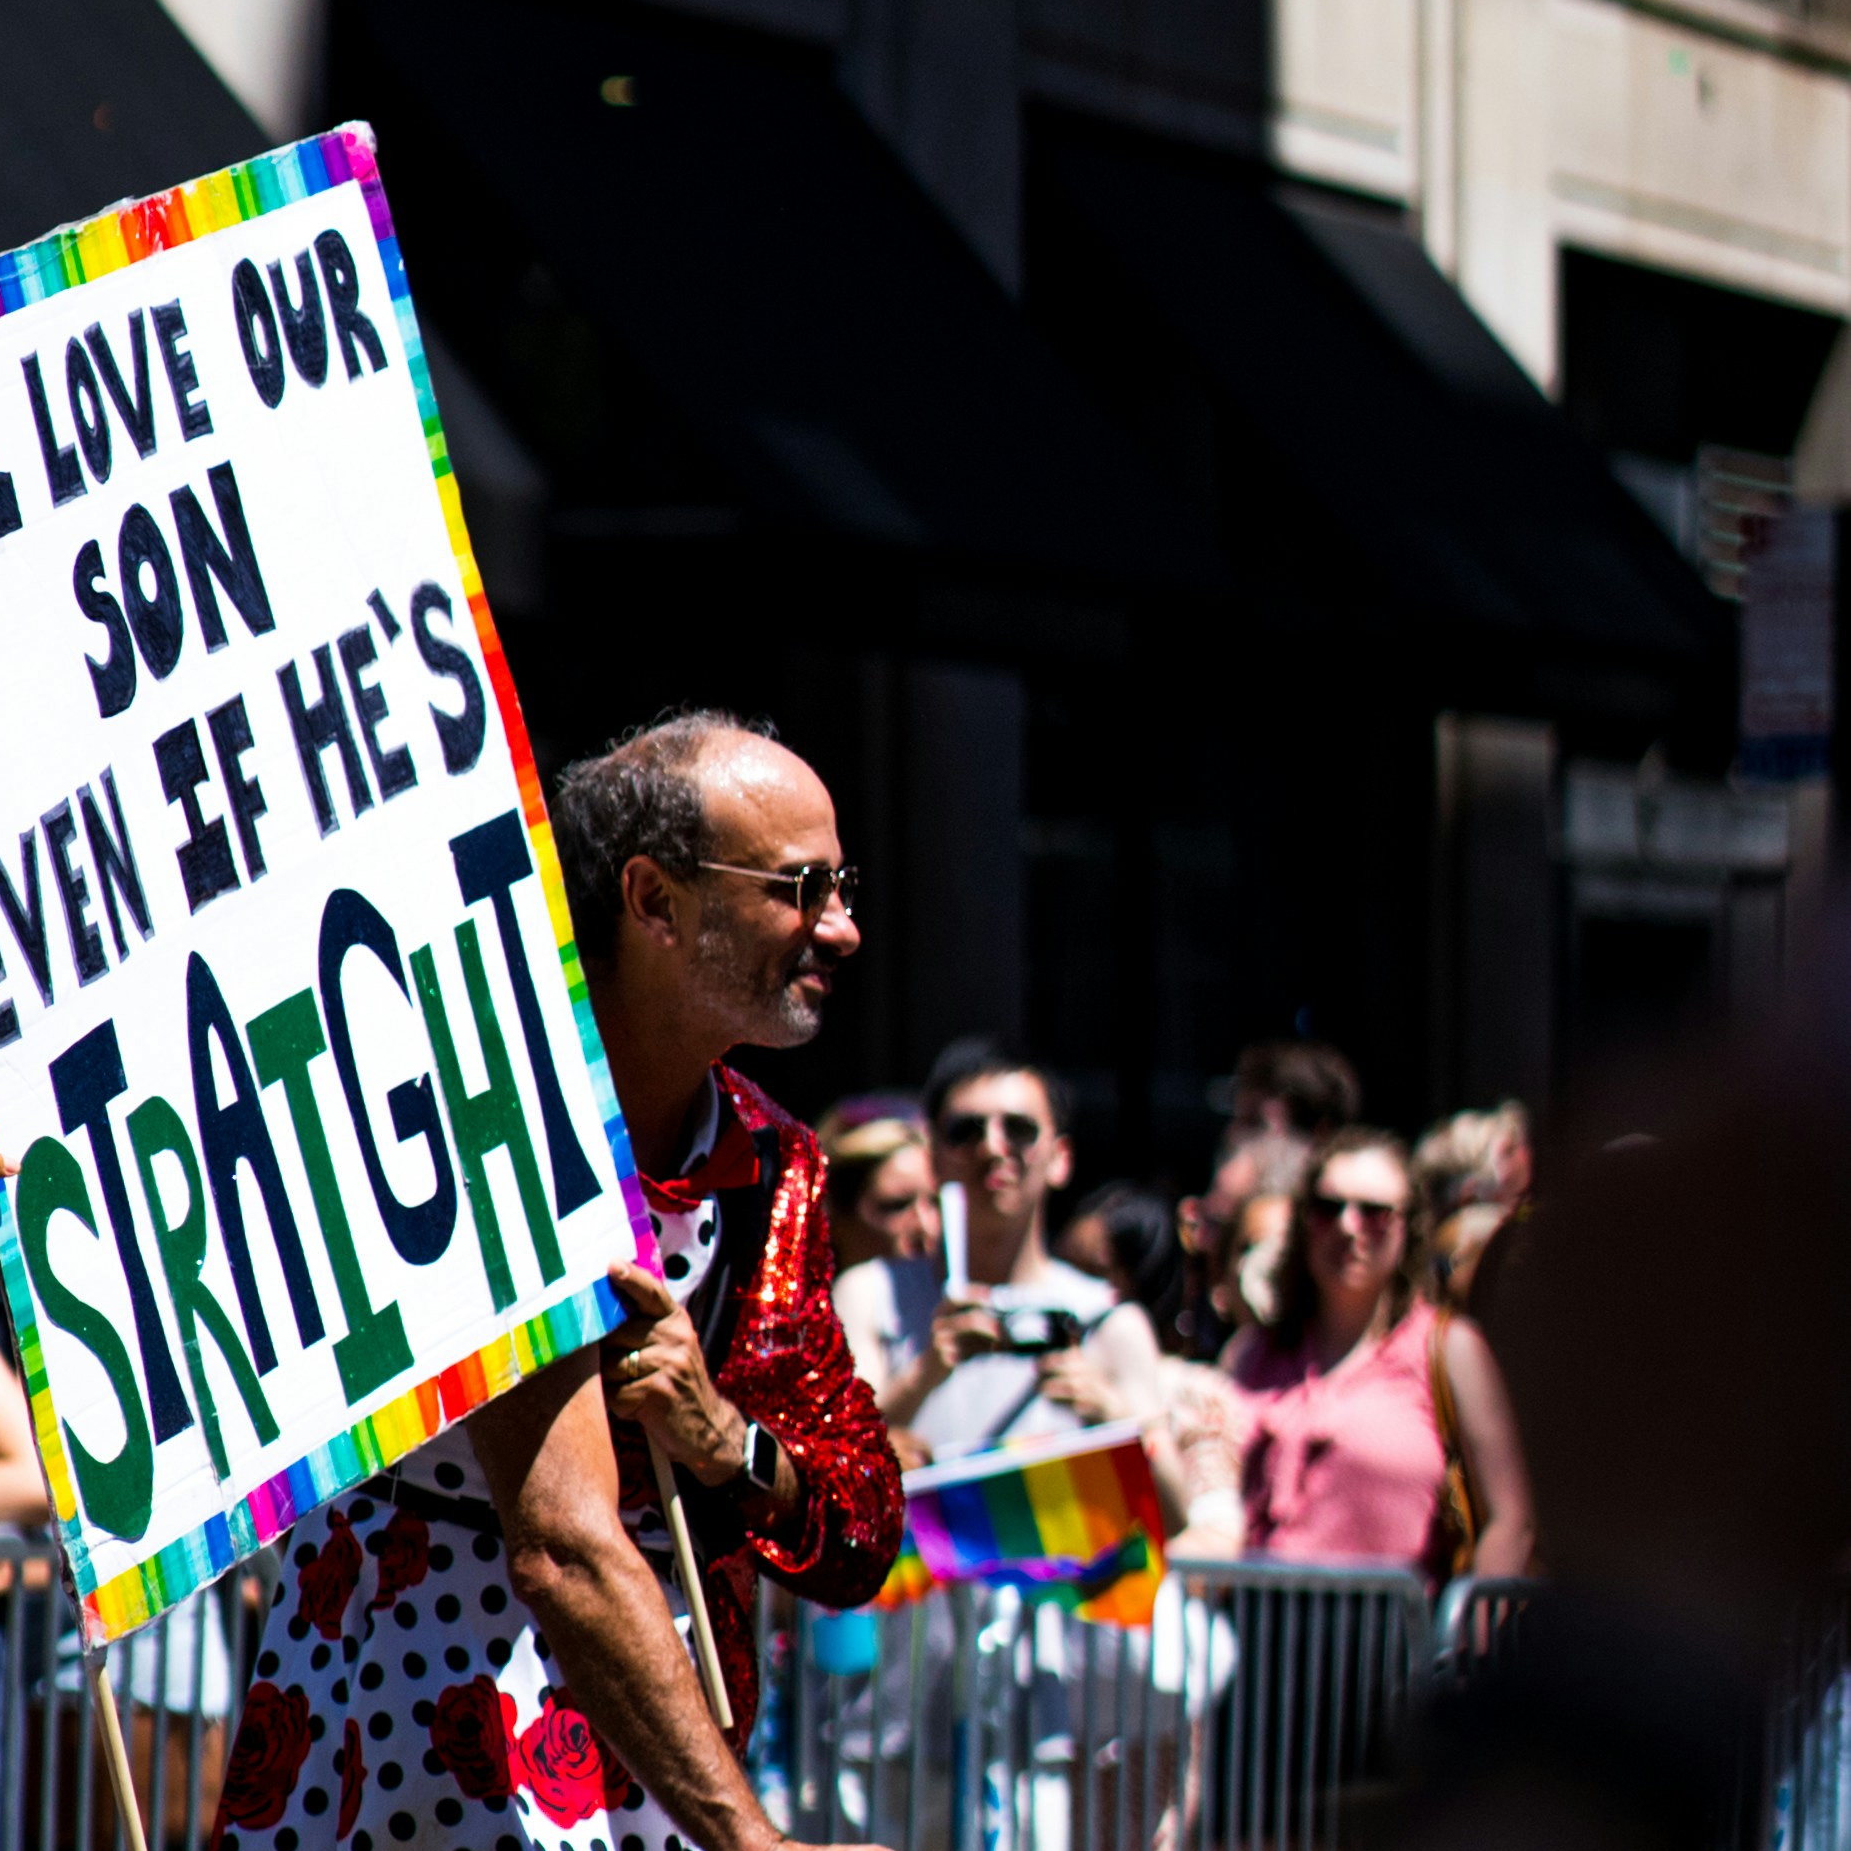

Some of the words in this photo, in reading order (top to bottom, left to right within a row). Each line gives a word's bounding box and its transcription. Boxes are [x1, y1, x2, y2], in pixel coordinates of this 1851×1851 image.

[20, 297, 214, 509] LOVE
[231, 228, 389, 410] OUR
[72, 459, 276, 719] SON
[151, 692, 268, 916] IF
[255, 578, 487, 841] HE'S
[15, 808, 604, 1543] STRAIGHT
